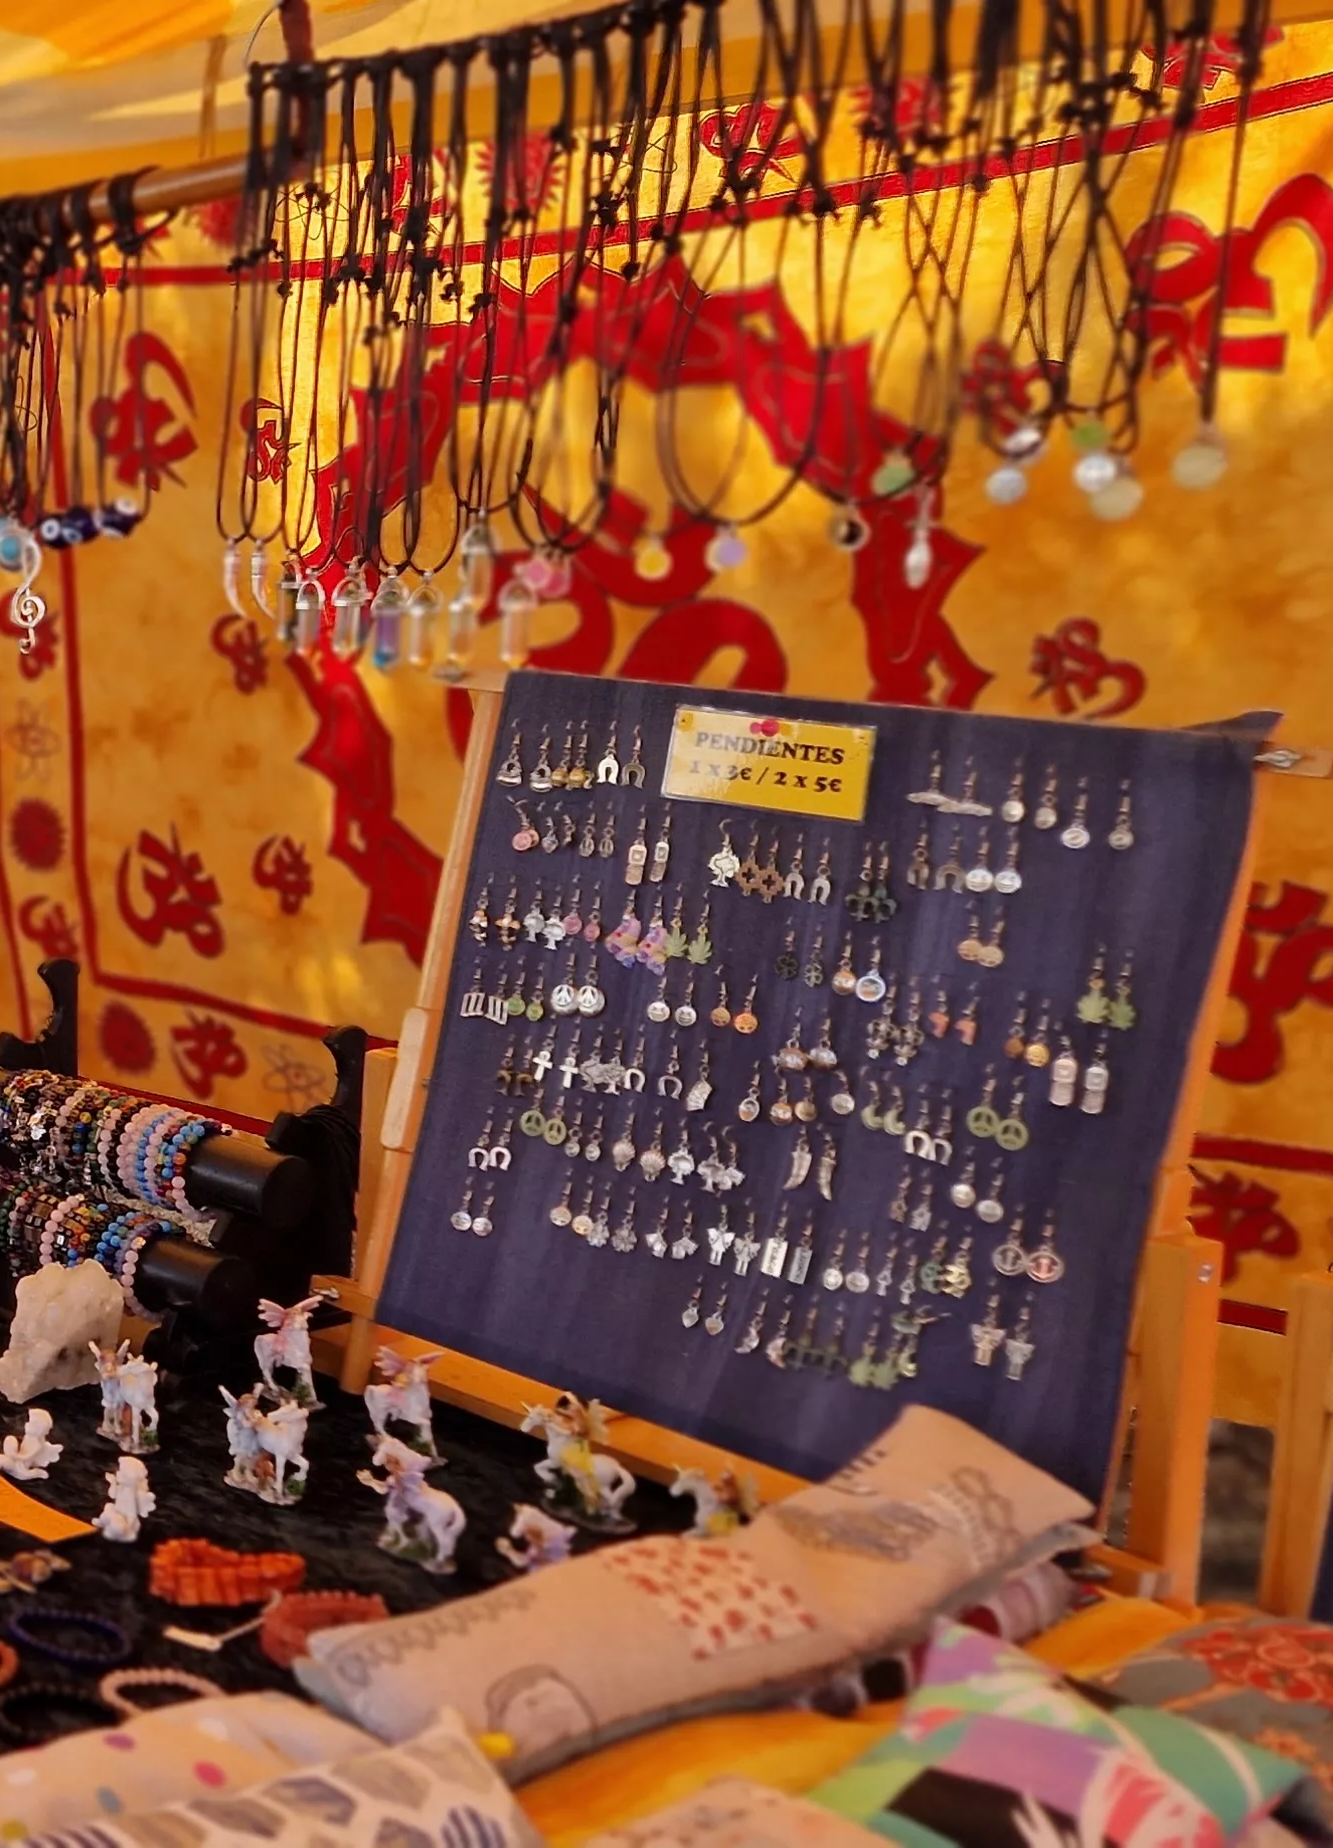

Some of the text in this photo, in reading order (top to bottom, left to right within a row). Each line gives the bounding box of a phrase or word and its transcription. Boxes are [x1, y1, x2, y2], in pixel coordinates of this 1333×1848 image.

[695, 731, 846, 765] PENDIENTES
[773, 771, 788, 785] 2
[793, 775, 809, 789] x
[814, 777, 843, 793] 5€
